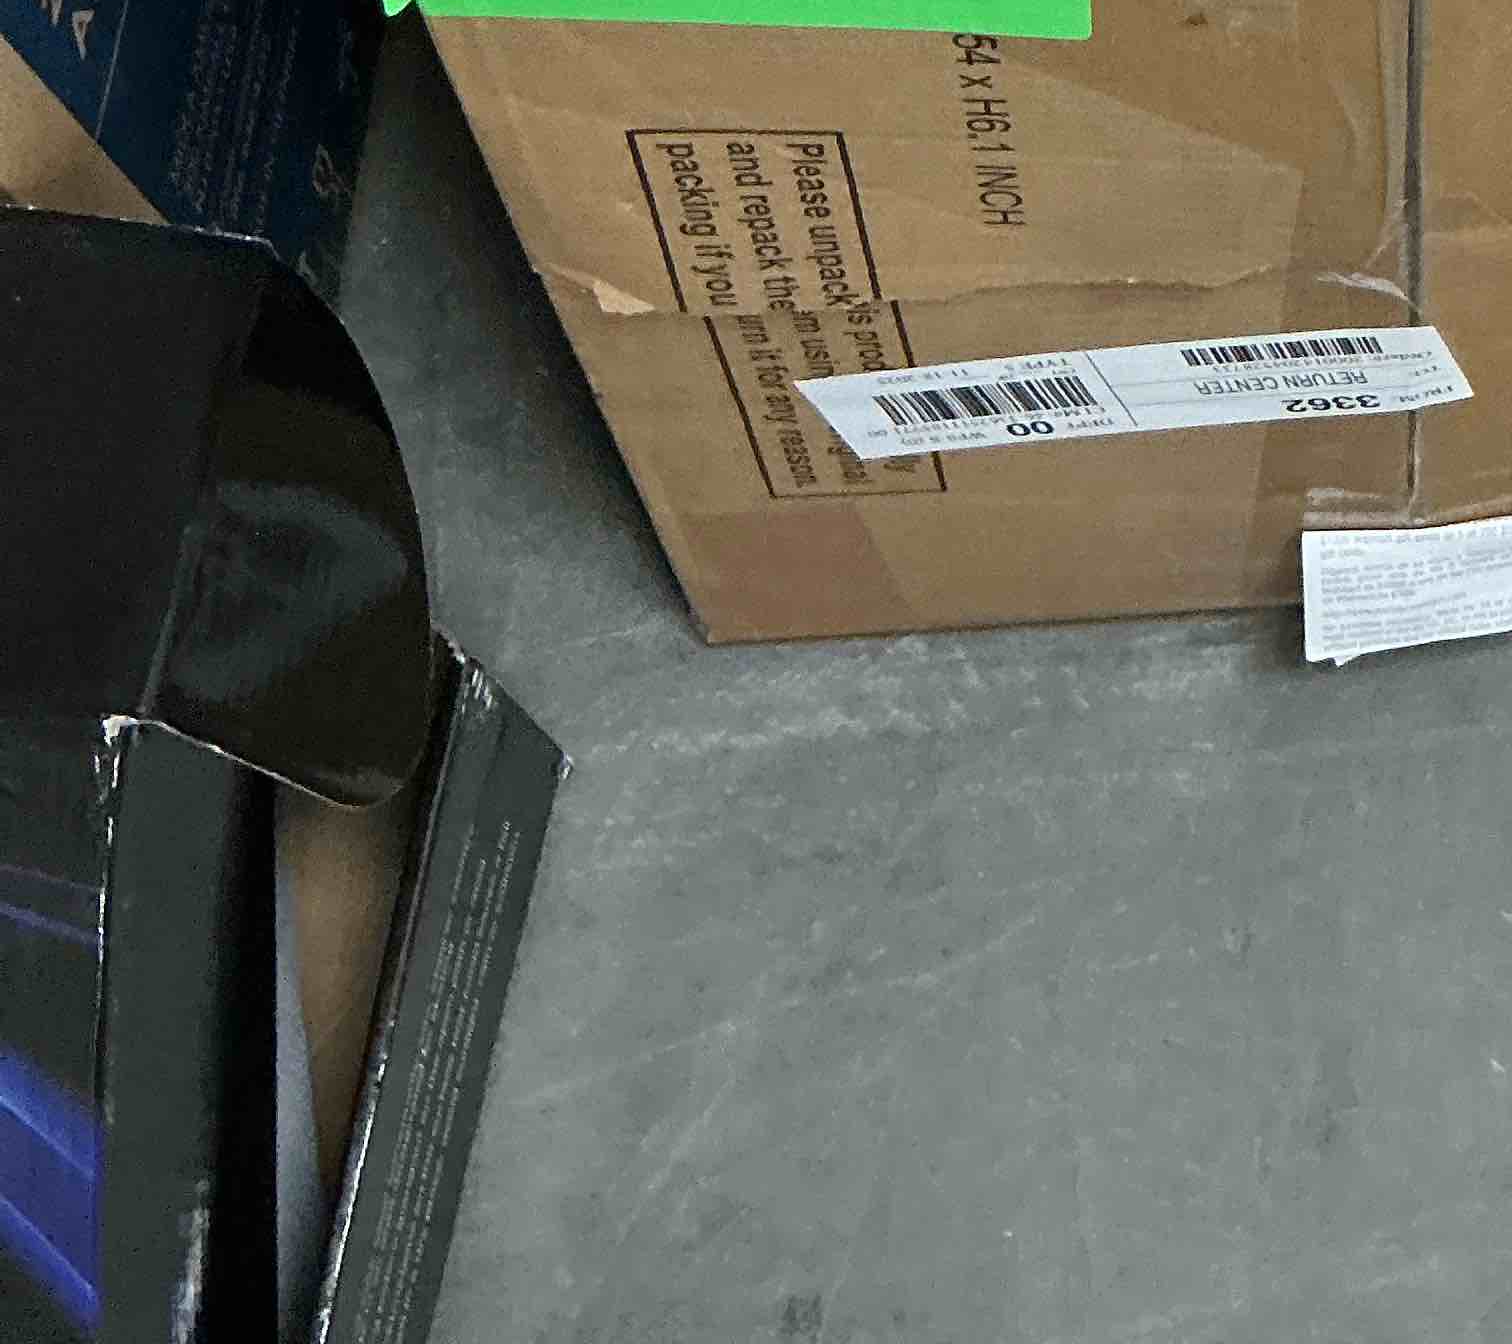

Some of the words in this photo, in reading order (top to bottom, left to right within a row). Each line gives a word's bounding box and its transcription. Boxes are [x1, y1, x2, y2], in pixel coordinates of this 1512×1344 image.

[726, 141, 773, 188] and
[786, 142, 832, 219] Please
[975, 164, 1027, 227] INCH
[655, 141, 720, 240] packing
[691, 262, 738, 307] you
[737, 193, 793, 270] repack
[806, 224, 861, 308] unpack
[1193, 374, 1279, 396] CENTER
[1283, 393, 1381, 414] 3362
[1286, 368, 1369, 390] RETURN
[1006, 419, 1055, 438] 00
